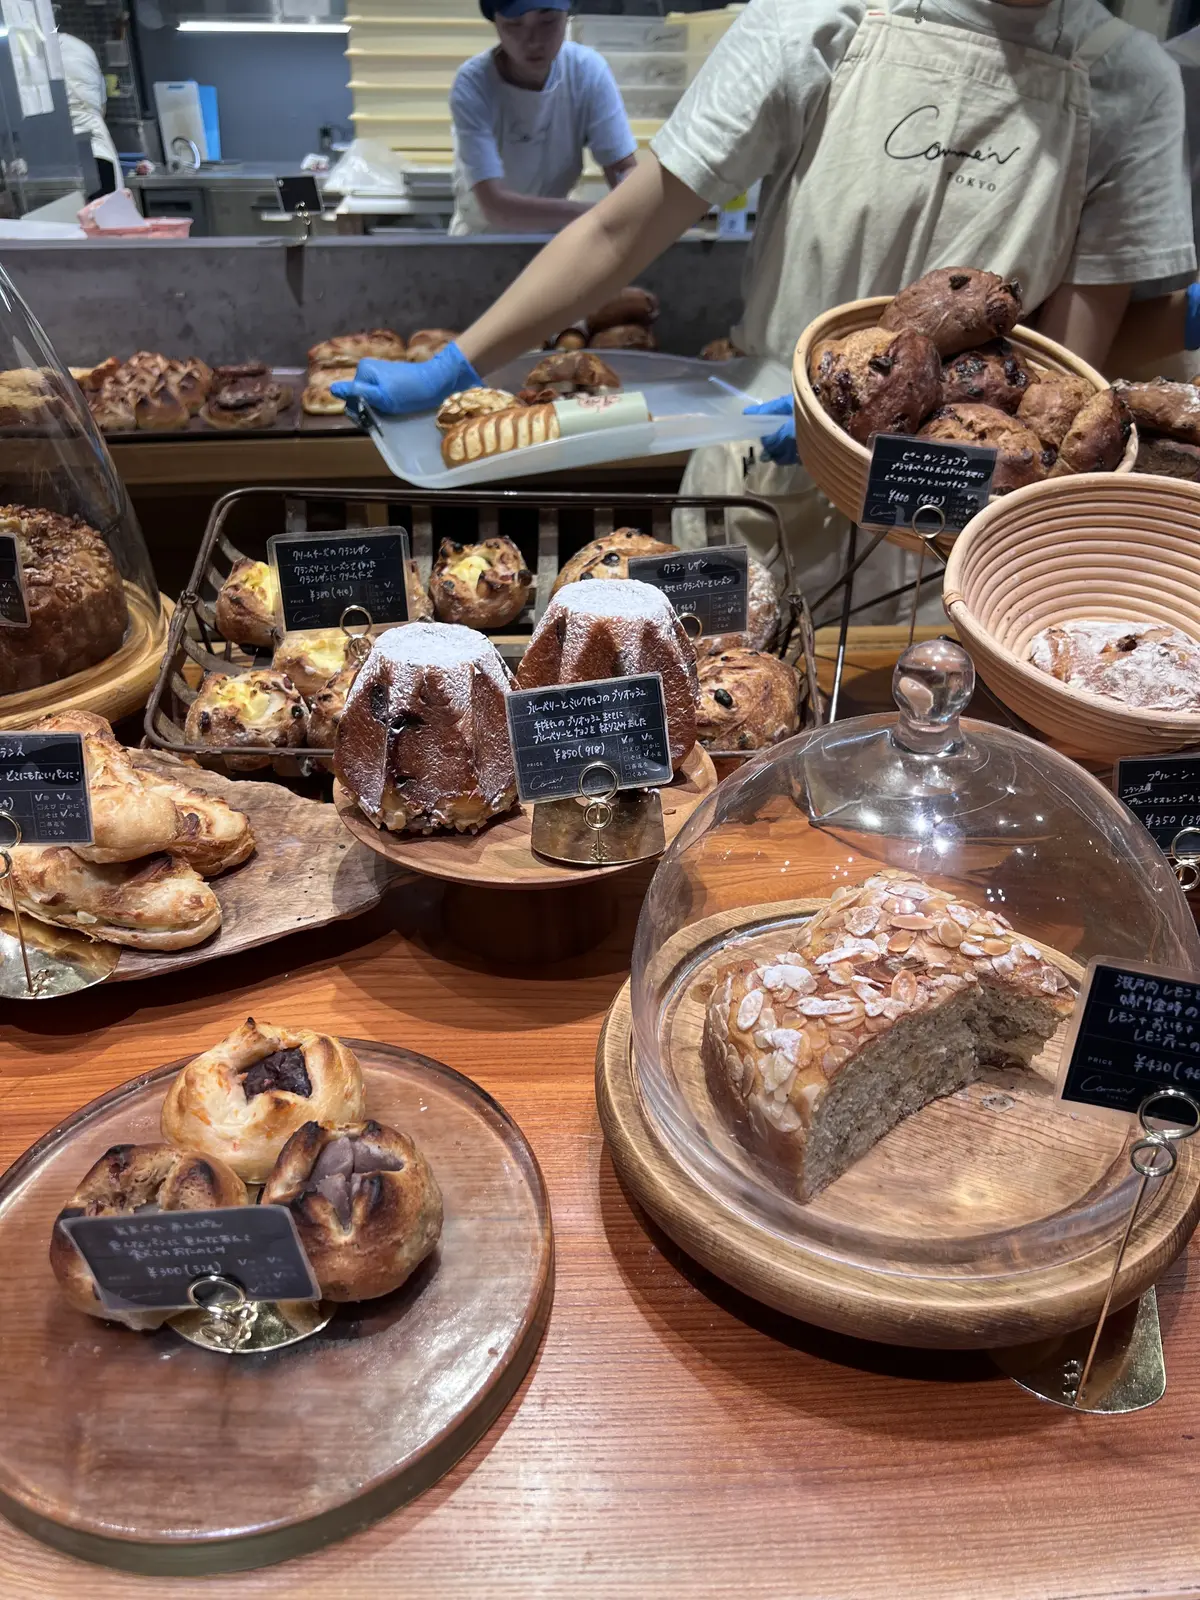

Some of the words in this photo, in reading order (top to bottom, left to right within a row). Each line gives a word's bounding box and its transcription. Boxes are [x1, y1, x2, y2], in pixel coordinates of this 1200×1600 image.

[946, 172, 997, 192] TOKYO
[1145, 813, 1176, 829] ¥350
[1119, 992, 1199, 1018] 鳴門金時の
[1087, 1055, 1113, 1066] PRICE
